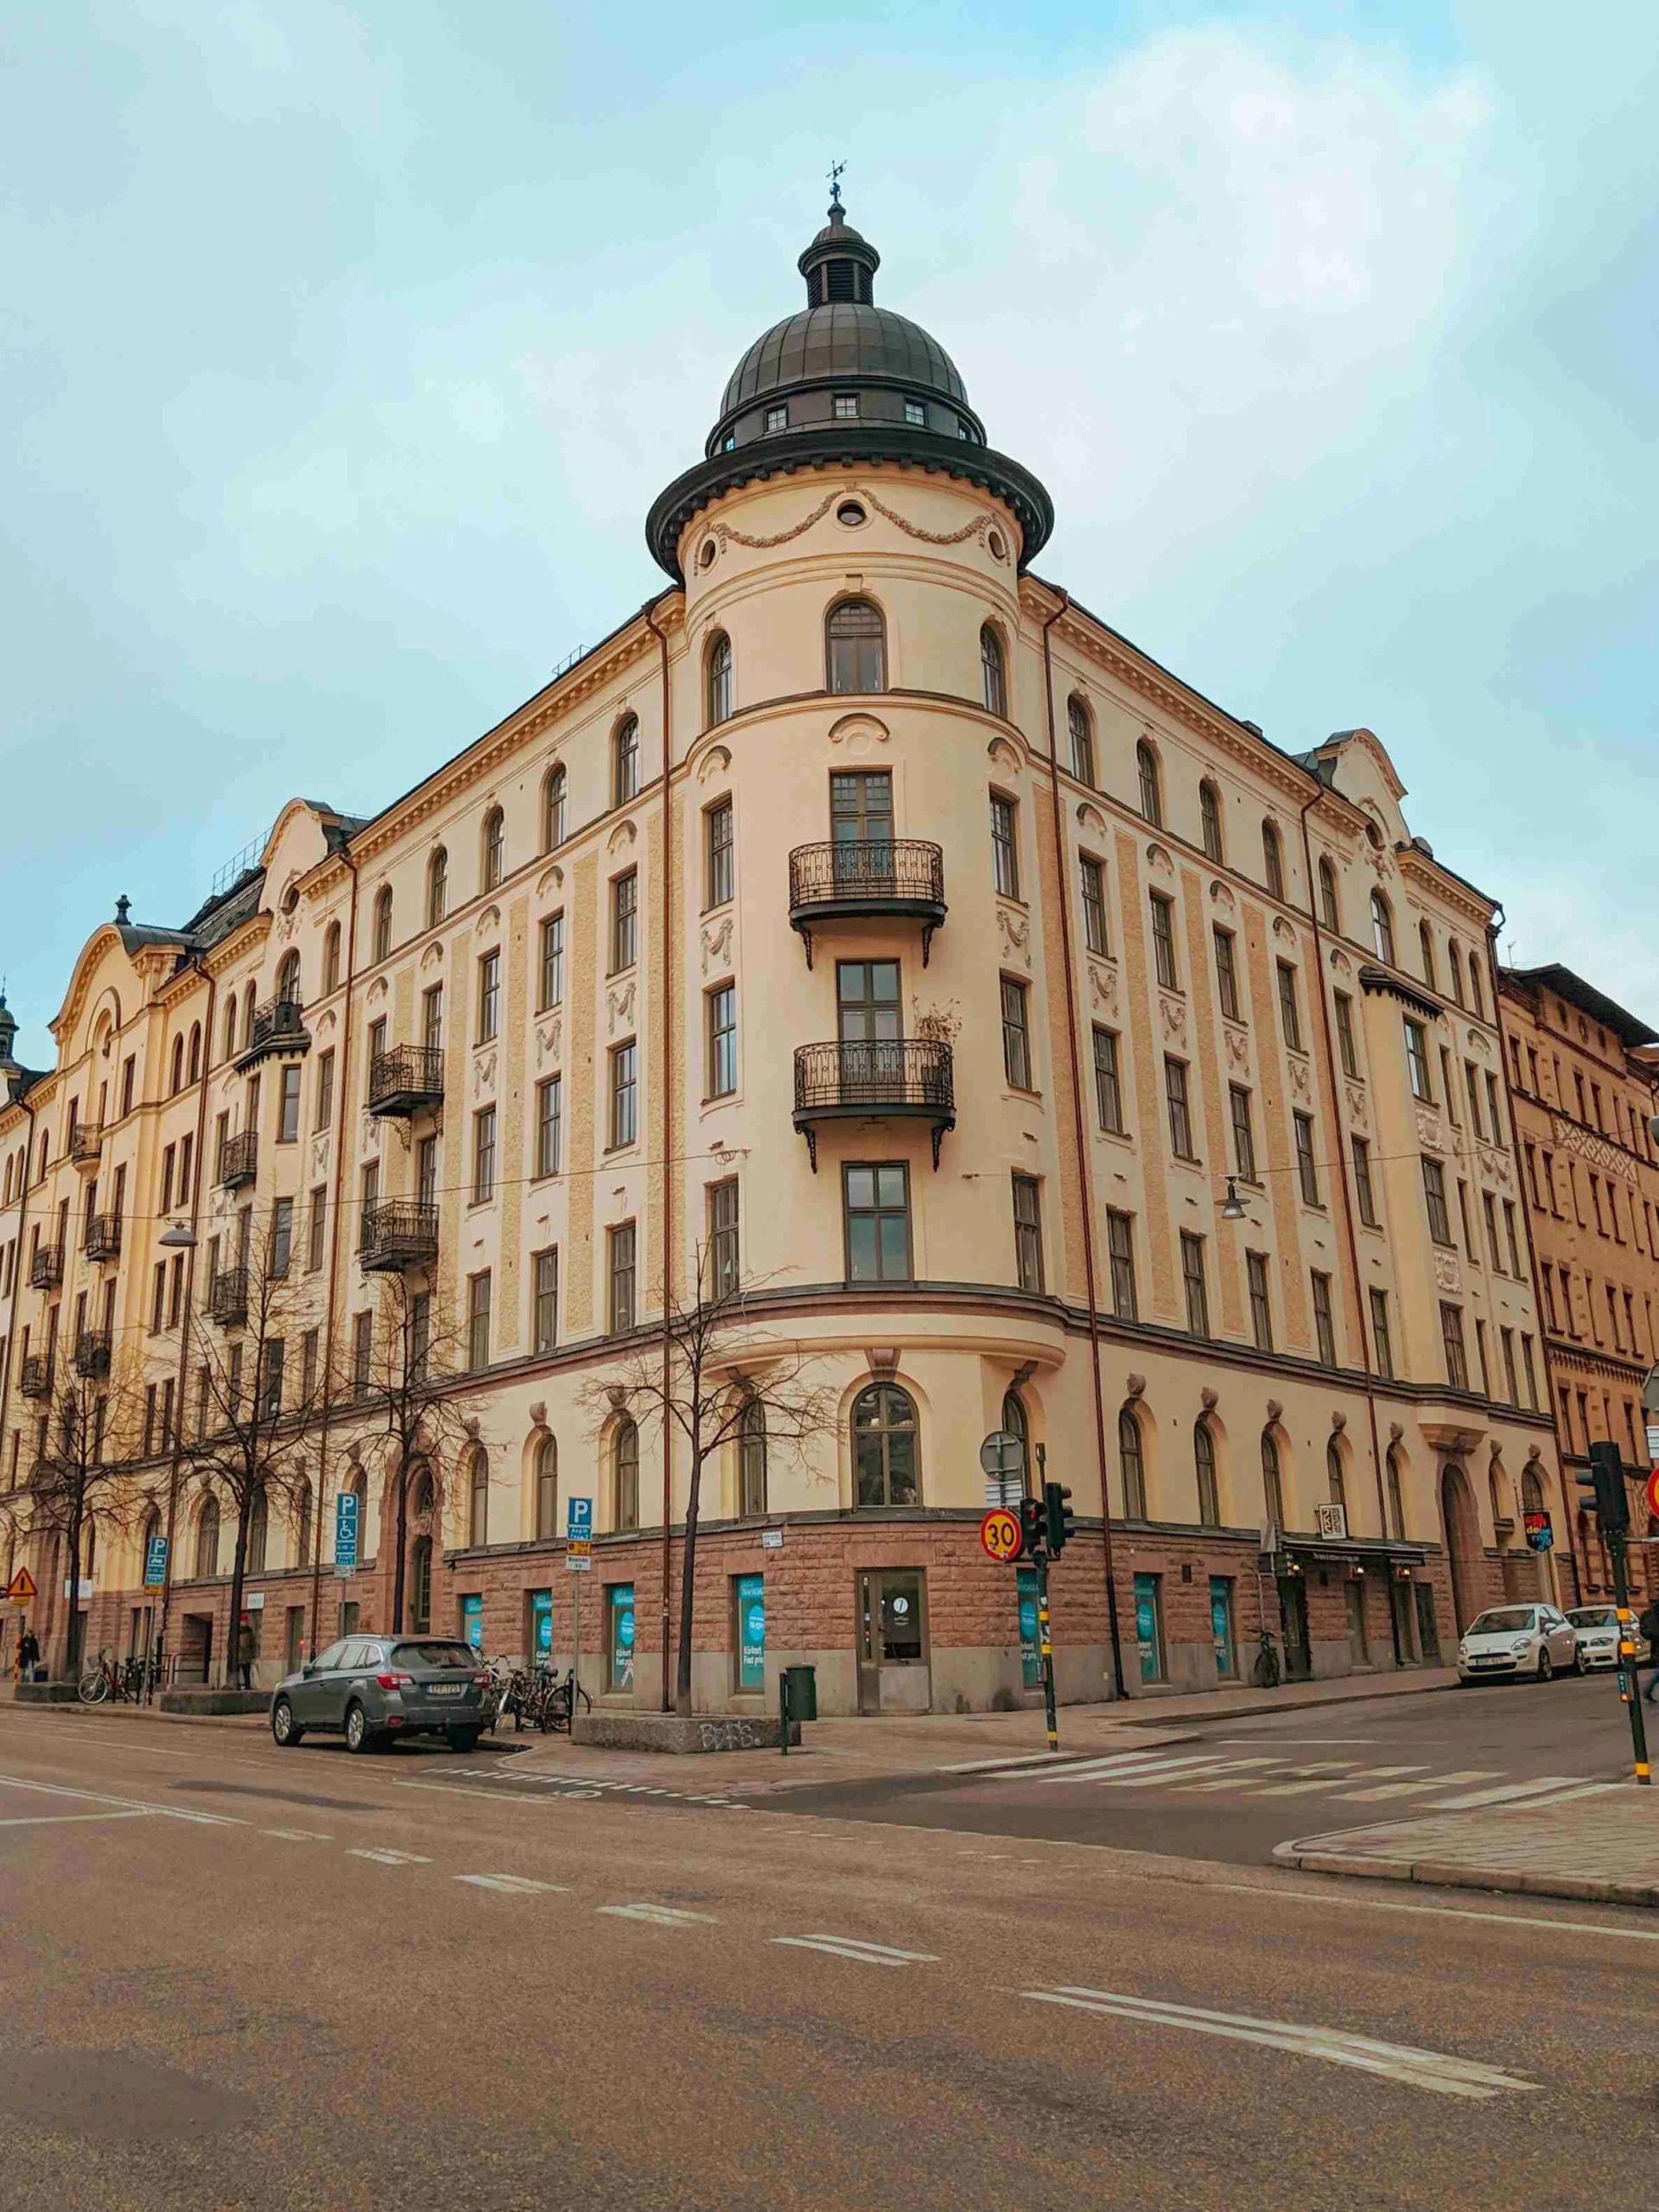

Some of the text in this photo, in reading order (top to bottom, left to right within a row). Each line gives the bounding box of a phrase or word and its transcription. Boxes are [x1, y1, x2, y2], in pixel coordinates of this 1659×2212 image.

[341, 1496, 354, 1516] P
[575, 1500, 588, 1523] P
[988, 1522, 1015, 1549] 30
[154, 1539, 165, 1554] P
